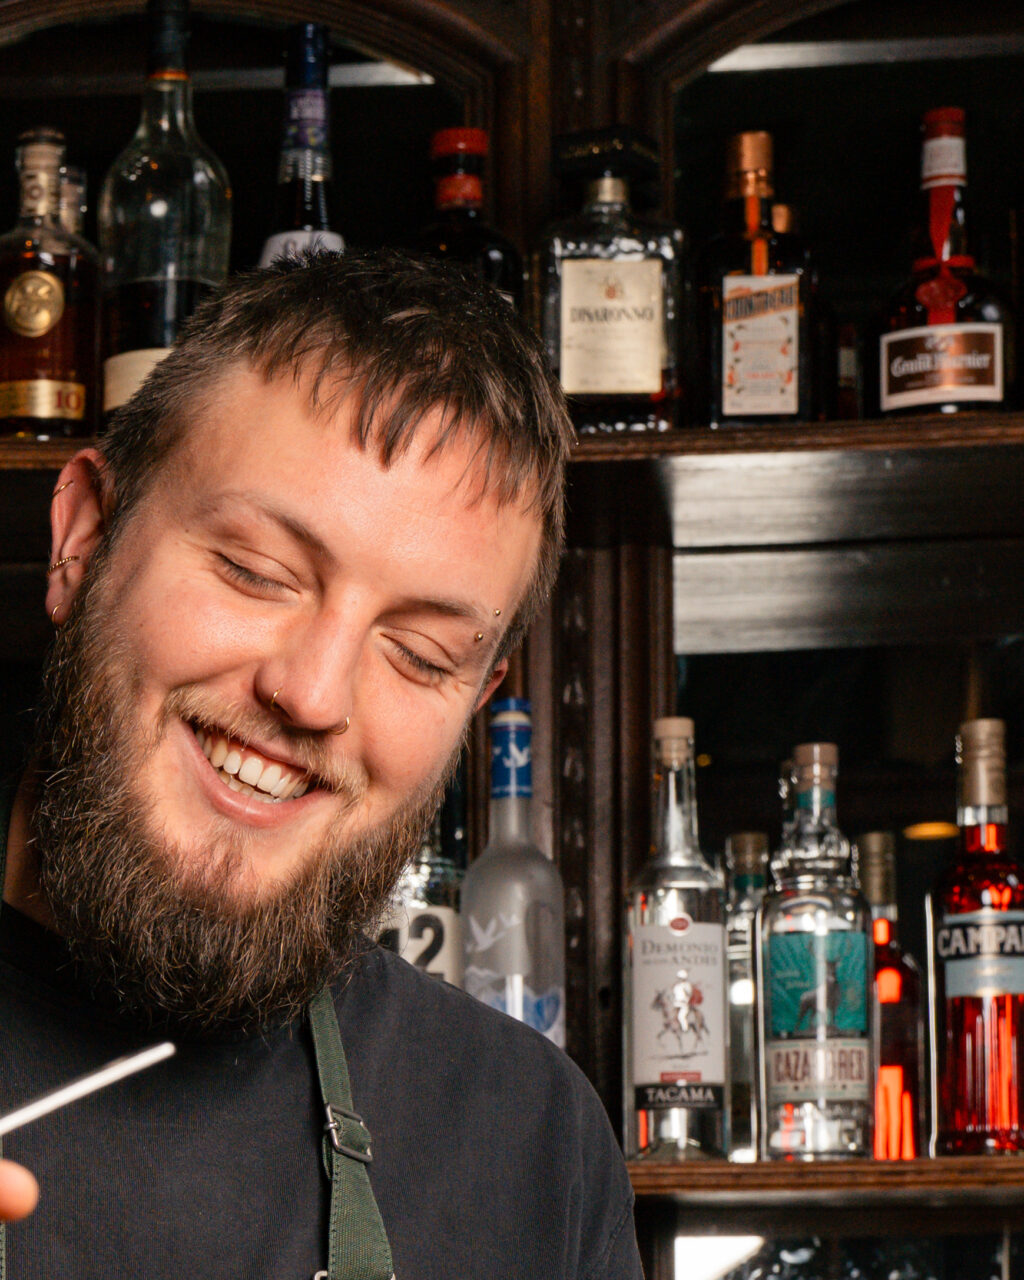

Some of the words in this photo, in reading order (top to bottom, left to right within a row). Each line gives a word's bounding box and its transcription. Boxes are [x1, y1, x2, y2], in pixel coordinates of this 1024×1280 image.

[55, 390, 81, 409] 10
[937, 924, 1024, 957] CAMPA
[647, 1087, 714, 1103] TACAMA
